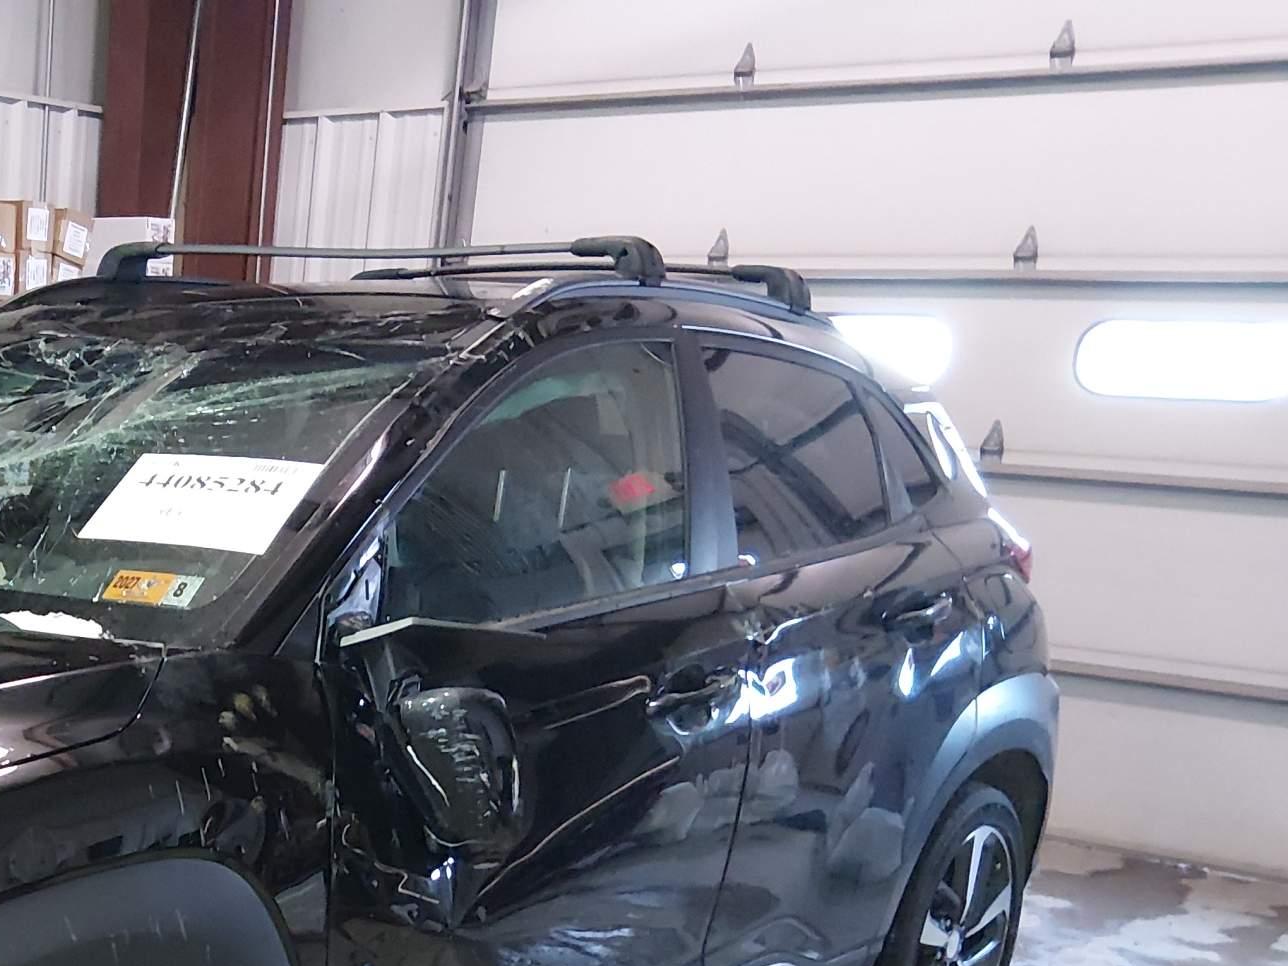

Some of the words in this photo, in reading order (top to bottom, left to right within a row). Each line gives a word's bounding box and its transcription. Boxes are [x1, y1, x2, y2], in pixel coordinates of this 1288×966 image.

[137, 473, 284, 496] 44085284
[113, 575, 142, 589] 2027
[172, 582, 188, 598] 8
